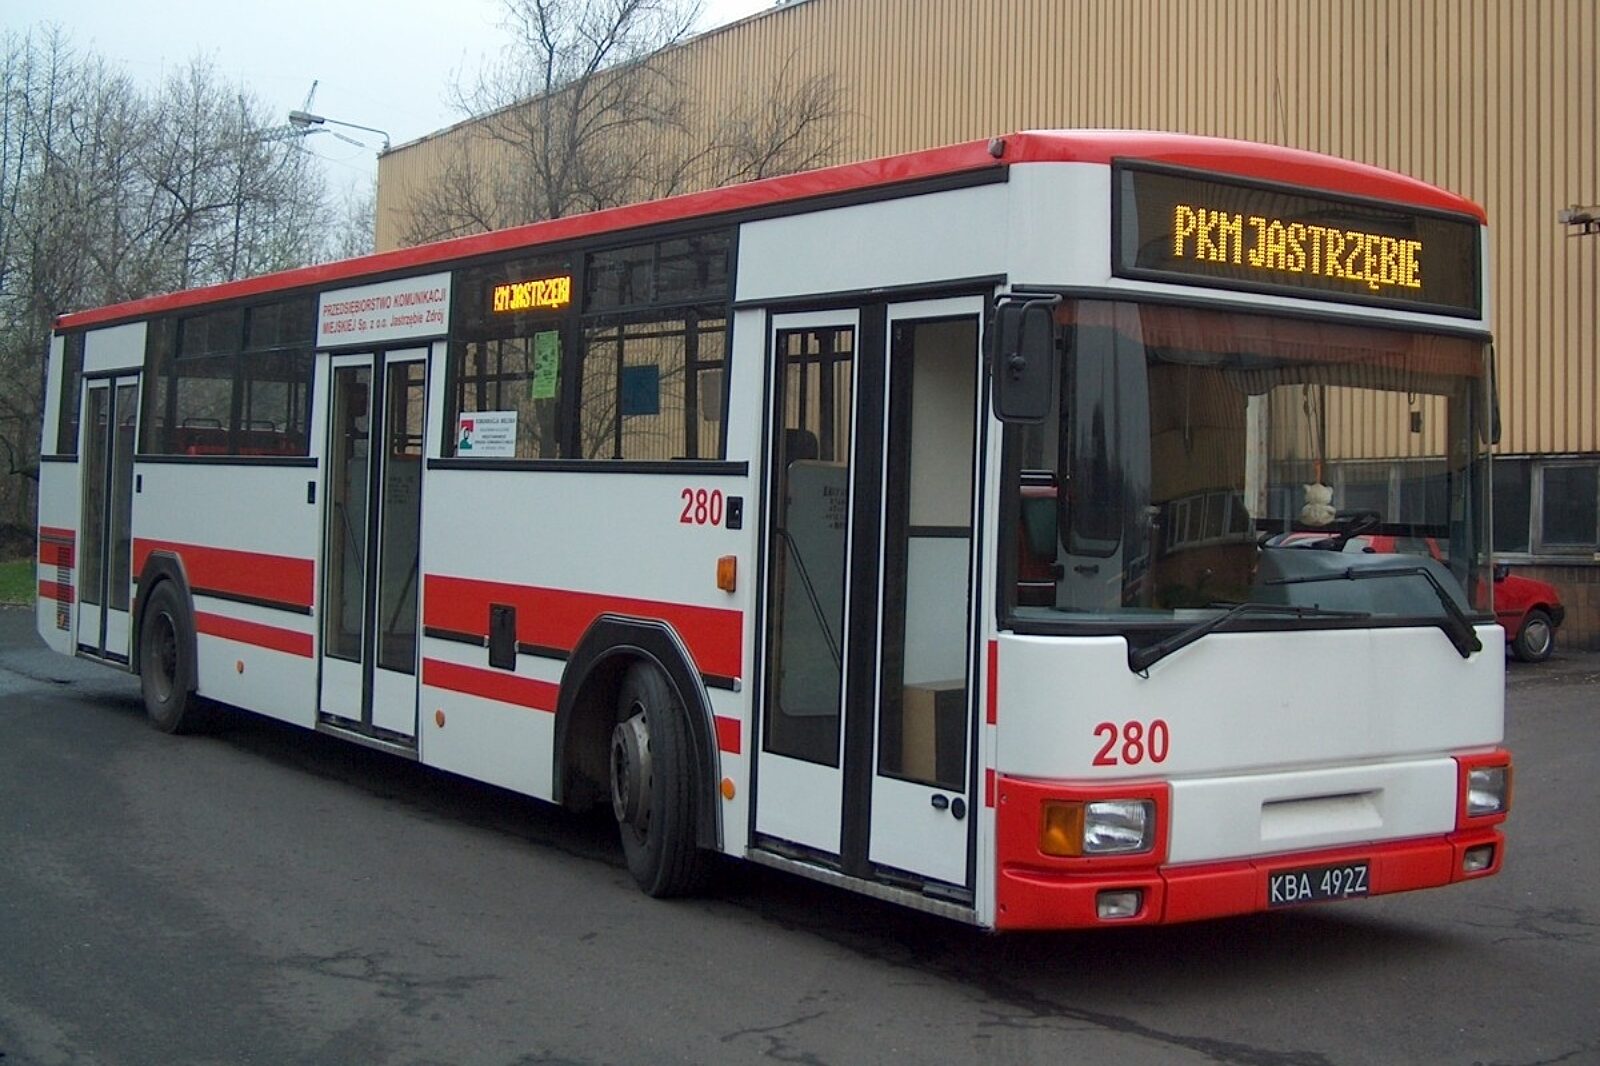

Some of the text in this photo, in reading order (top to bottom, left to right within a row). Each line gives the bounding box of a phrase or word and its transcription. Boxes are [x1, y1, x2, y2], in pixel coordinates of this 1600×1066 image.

[1174, 205, 1421, 290] PKM JASTRZĘBIE
[394, 288, 446, 307] KOMUNIKACJI
[323, 319, 356, 334] MIEJSKIEJ
[425, 309, 444, 324] Zdrój
[680, 488, 722, 526] 280
[1092, 719, 1169, 766] 280
[1271, 866, 1367, 902] KBA 492Z
